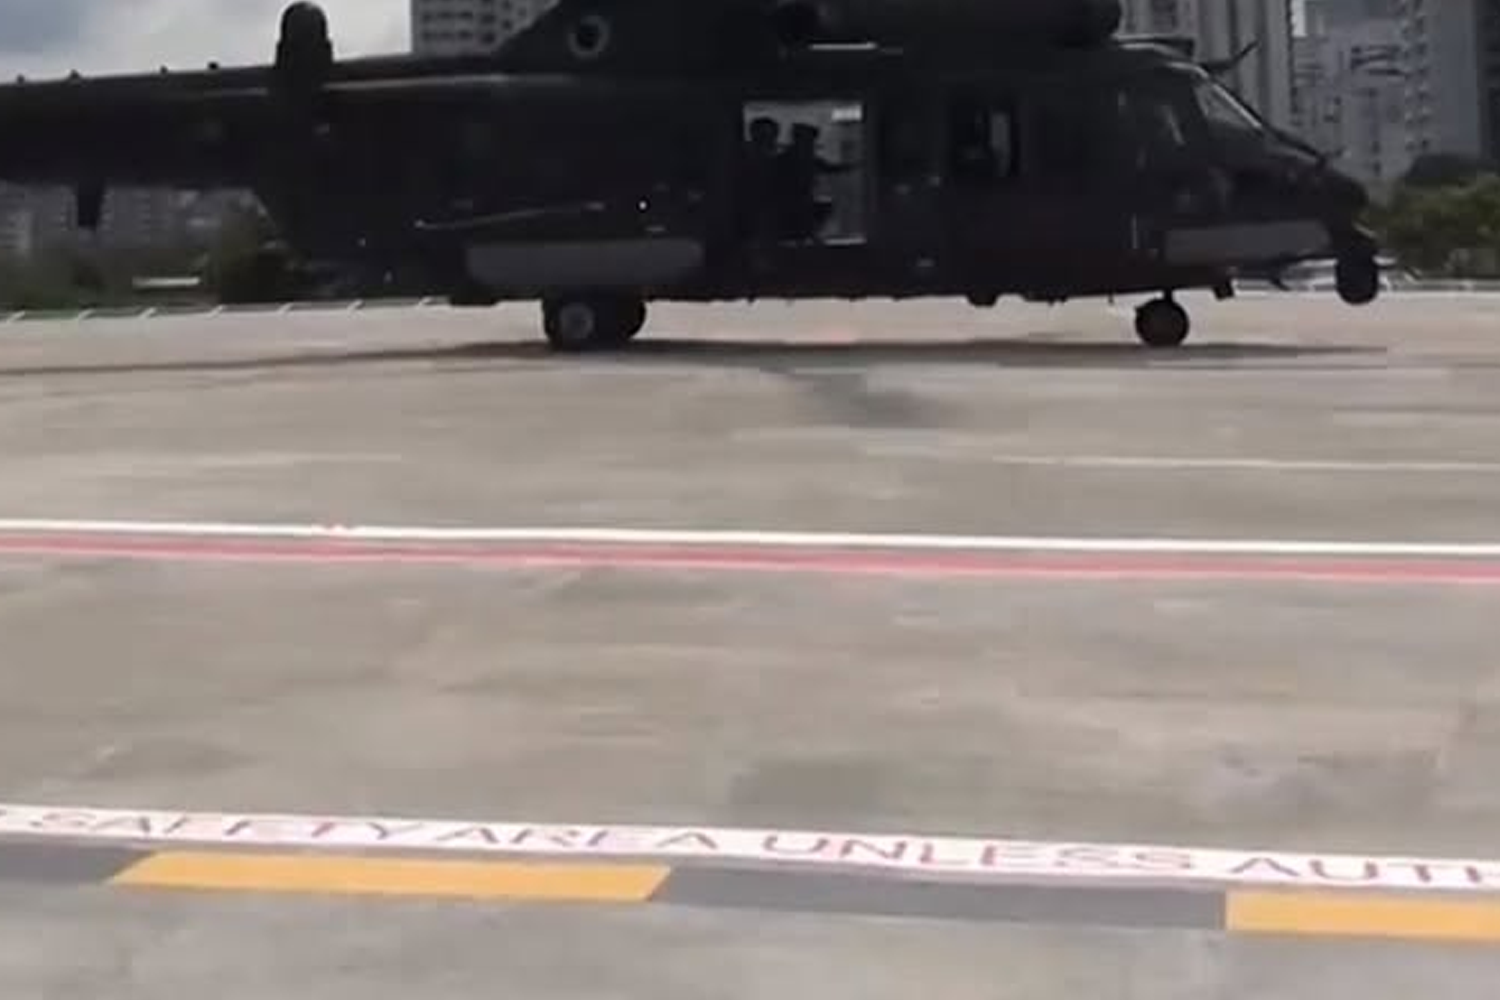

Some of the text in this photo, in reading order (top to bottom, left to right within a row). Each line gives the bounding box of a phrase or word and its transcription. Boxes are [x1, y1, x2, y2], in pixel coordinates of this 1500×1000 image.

[29, 811, 424, 840] SAFETY
[435, 826, 718, 850] AREA
[762, 834, 1198, 870] UNLESS
